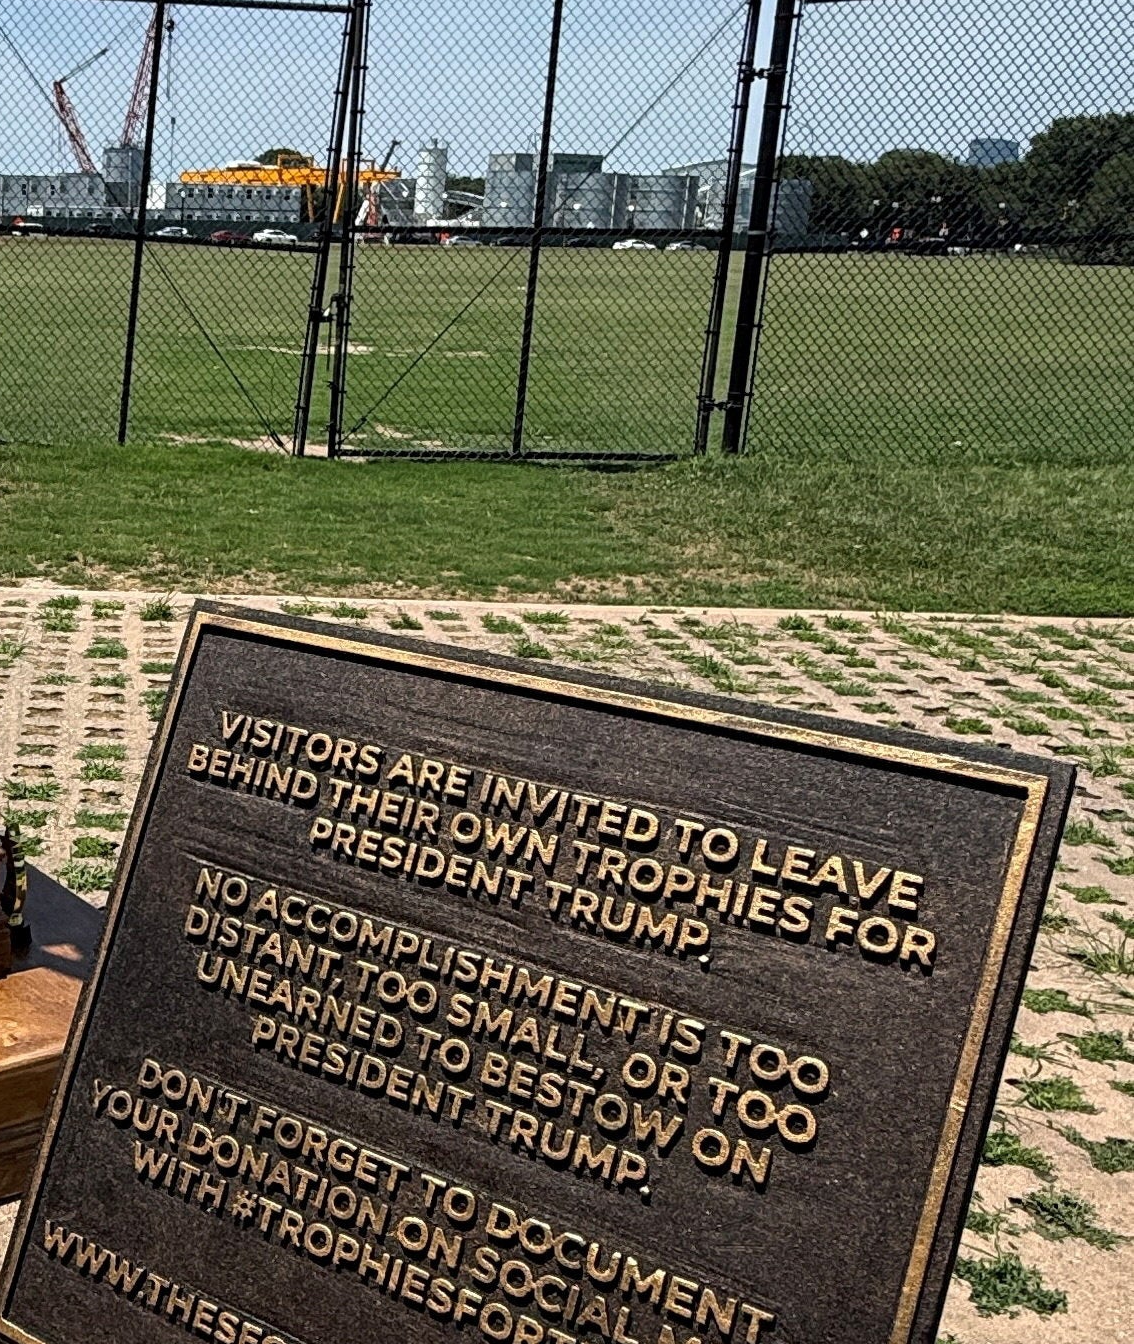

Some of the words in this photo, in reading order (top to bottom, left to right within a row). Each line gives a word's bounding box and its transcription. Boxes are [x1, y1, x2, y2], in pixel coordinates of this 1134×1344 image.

[187, 743, 317, 800] BEHIND
[328, 777, 440, 835] THEIR
[451, 812, 558, 865] OWN
[572, 840, 813, 933] TROPHIES
[825, 906, 936, 966] FOR
[221, 711, 382, 775] VISITORS
[387, 754, 471, 797] ARE
[479, 773, 658, 842] INVITED
[675, 818, 738, 863] TO
[751, 839, 924, 910] LEAVE
[309, 817, 533, 901] PRESIDENT
[544, 880, 710, 964] TRUMP.
[184, 904, 343, 990] DISTANT,
[356, 960, 438, 1014] TOO
[446, 992, 604, 1080] SMALL,
[622, 1052, 690, 1104] OR
[709, 1076, 816, 1143] TOO
[195, 867, 248, 906] NO
[255, 889, 649, 1034] ACCOMPLISHMENT
[659, 1014, 705, 1055] IS
[719, 1030, 829, 1094] TOO
[196, 951, 403, 1048] UNEARNED
[416, 1026, 471, 1073] TO
[479, 1051, 683, 1149] BESTOW
[691, 1128, 771, 1184] ON
[92, 1078, 180, 1143] YOUR
[185, 1122, 388, 1235] DONATION
[395, 1216, 463, 1268] ON
[133, 1139, 226, 1208] WITH
[137, 1058, 249, 1125] DON'T
[252, 1105, 410, 1193] FORGET
[420, 1173, 476, 1222] TO
[251, 1016, 475, 1120] PRESIDENT
[484, 1099, 651, 1196] TRUMP.
